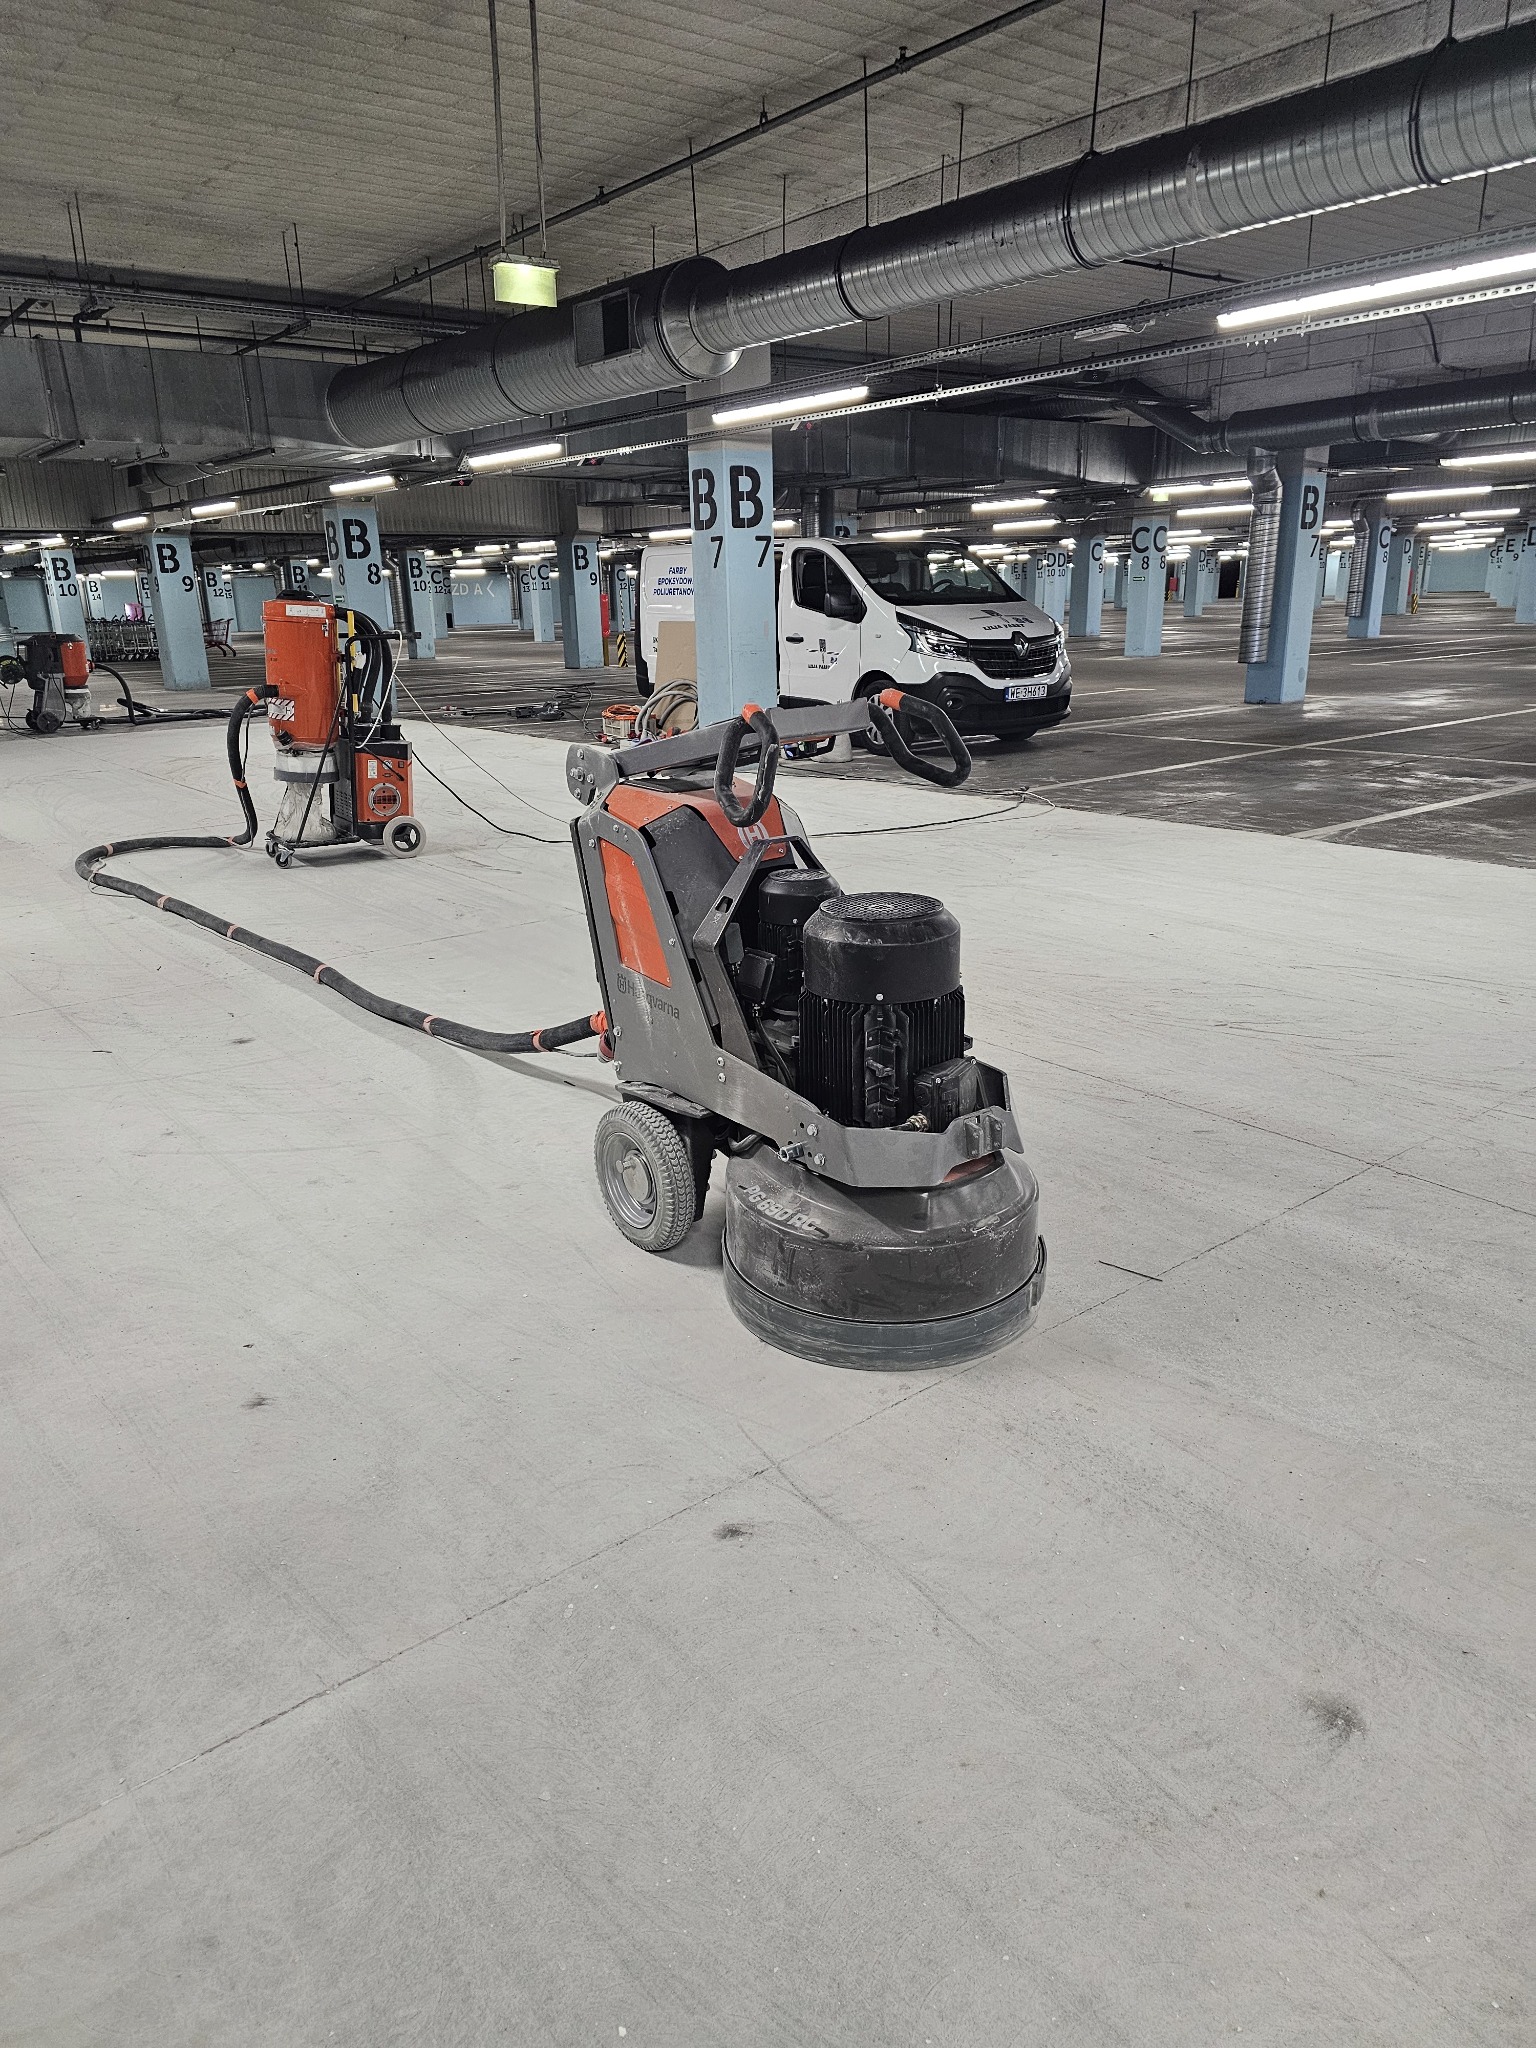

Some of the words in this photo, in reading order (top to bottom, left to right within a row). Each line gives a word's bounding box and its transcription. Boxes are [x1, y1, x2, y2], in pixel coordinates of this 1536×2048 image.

[692, 468, 717, 530] B
[730, 465, 763, 528] B
[1301, 485, 1319, 529] B
[326, 521, 339, 560] B
[342, 519, 371, 559] B
[1132, 527, 1150, 553] C
[1154, 526, 1167, 552] C
[1380, 526, 1390, 548] C
[711, 536, 723, 568] 7
[755, 536, 772, 567] 7
[1092, 543, 1102, 561] C
[1310, 535, 1319, 557] 7
[1404, 539, 1411, 554] D
[1496, 545, 1503, 556] F
[1506, 539, 1515, 552] E
[156, 544, 180, 573] B
[574, 545, 589, 570] B
[1047, 553, 1056, 567] D
[1058, 553, 1066, 567] D
[1142, 556, 1149, 570] 8
[1160, 555, 1166, 569] 8
[1199, 550, 1206, 562] D
[1383, 551, 1388, 564] 8
[1513, 553, 1519, 561] 9
[51, 558, 71, 581] B
[409, 558, 423, 578] B
[668, 567, 687, 575] FARBY
[1014, 563, 1018, 573] E
[1037, 559, 1043, 570] D
[1099, 563, 1103, 573] 9
[206, 572, 217, 587] B
[293, 566, 305, 583] B
[339, 564, 345, 585] 8
[368, 563, 381, 585] 8
[431, 570, 442, 584] C
[521, 574, 529, 585] C
[530, 565, 536, 580] C
[538, 565, 549, 580] C
[590, 572, 597, 585] 9
[617, 569, 625, 581] C
[89, 581, 99, 592] B
[141, 577, 149, 590] B
[182, 576, 194, 592] 9
[413, 580, 426, 591] 10
[443, 577, 450, 587] C
[452, 583, 469, 595] ZD
[474, 583, 483, 595] A
[541, 582, 551, 590] 11
[59, 584, 77, 596] 10
[213, 589, 224, 597] 12
[1010, 687, 1021, 698] WE
[1023, 685, 1046, 696] 3H613
[627, 979, 680, 1020] Hqvarna
